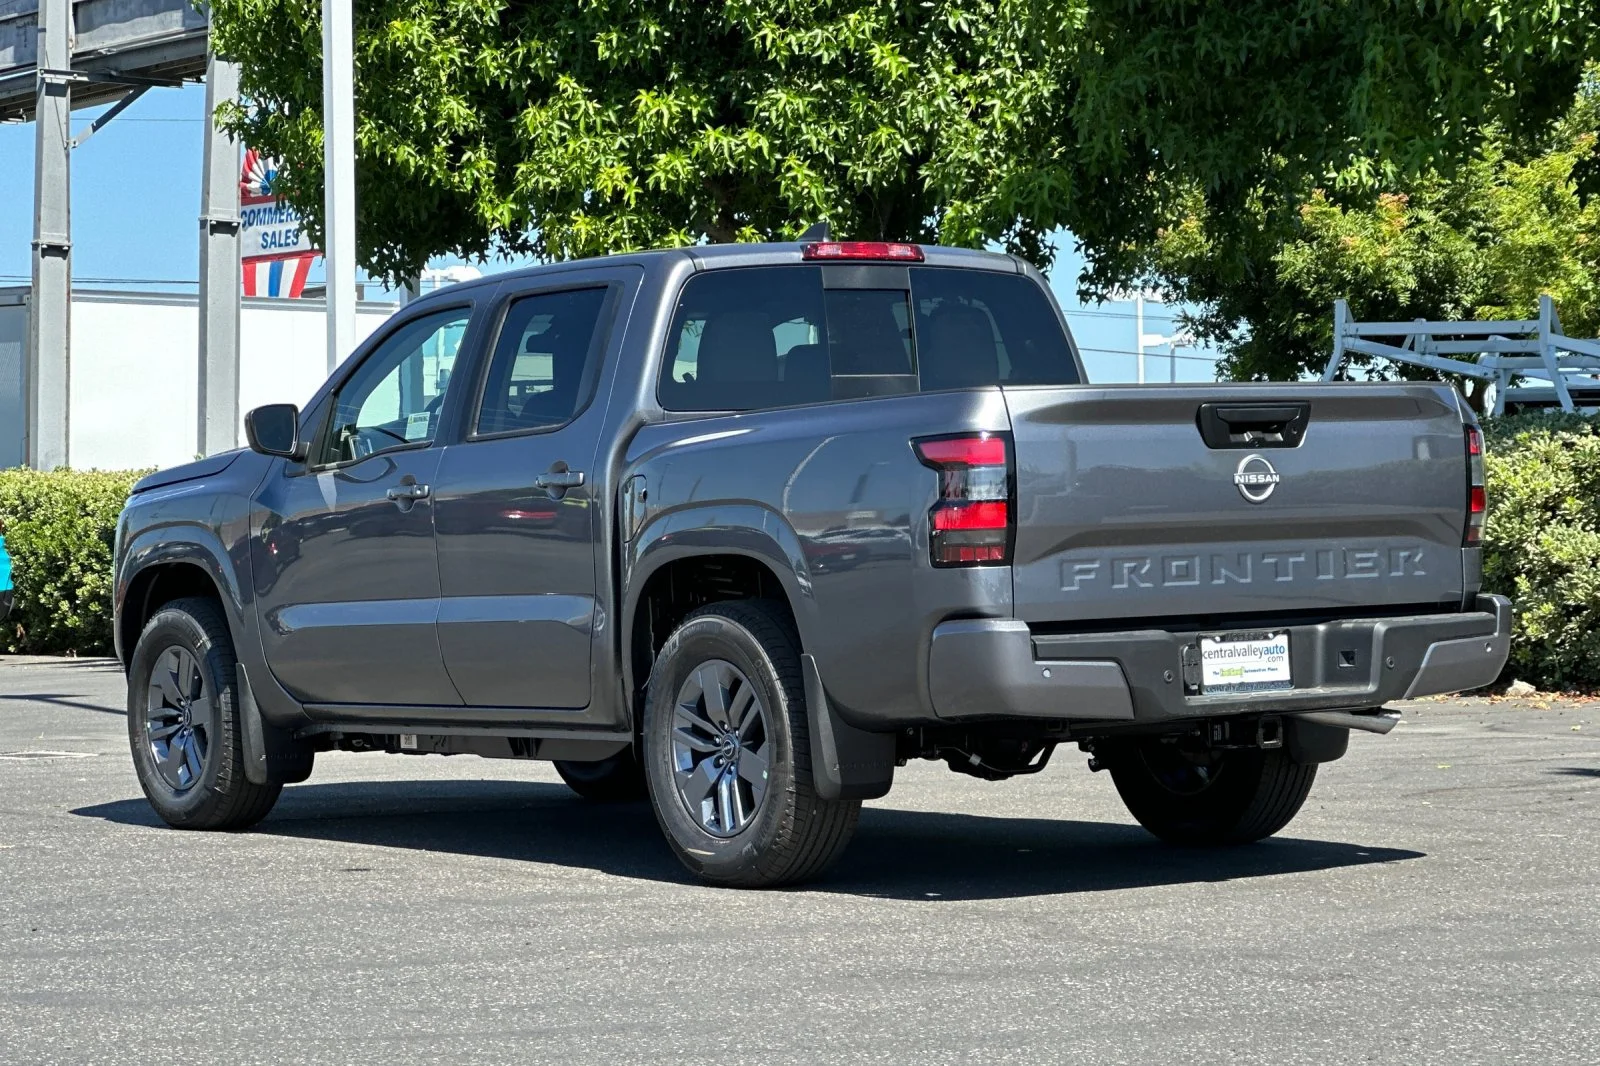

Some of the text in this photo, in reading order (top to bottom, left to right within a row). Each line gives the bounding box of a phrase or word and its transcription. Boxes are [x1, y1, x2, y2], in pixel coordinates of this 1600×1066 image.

[261, 229, 299, 249] SALES
[1235, 474, 1280, 484] NISSAN
[1060, 547, 1427, 592] FRONTIER
[1202, 644, 1285, 659] centralvalleyauto
[1266, 655, 1284, 663] .com
